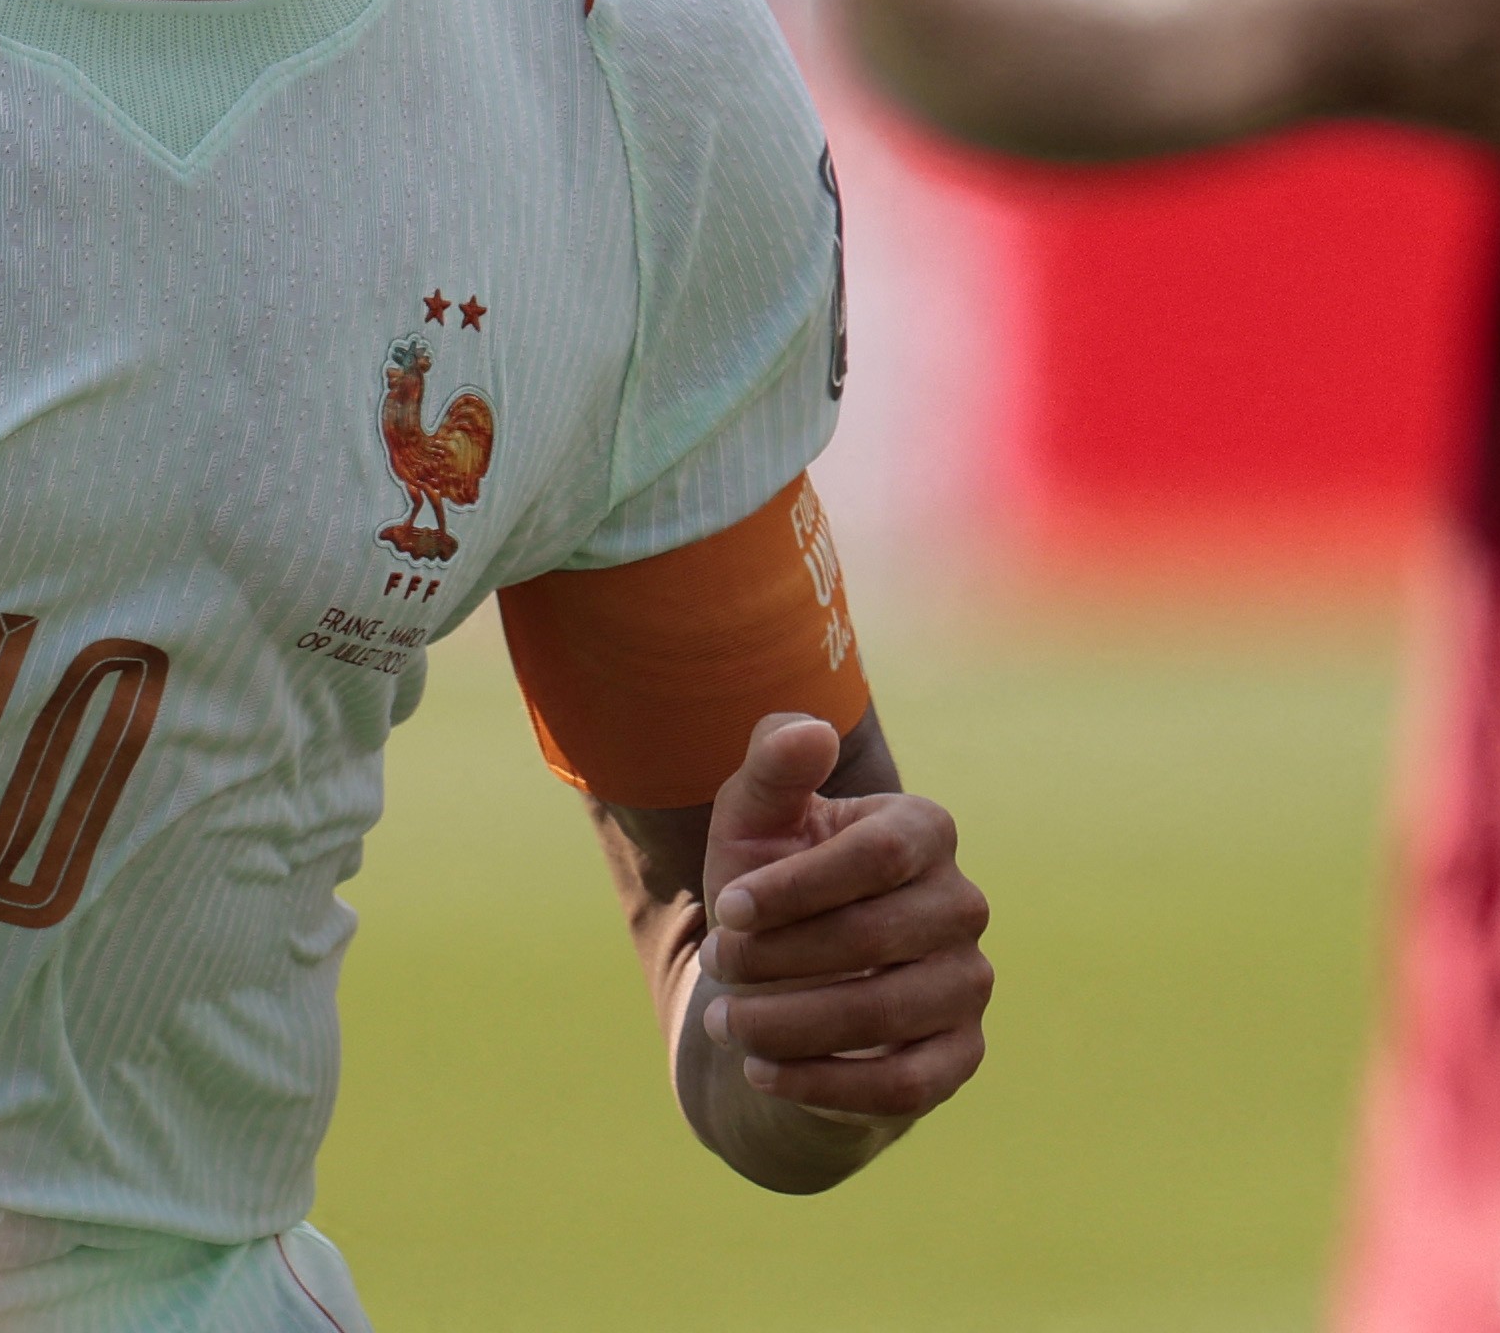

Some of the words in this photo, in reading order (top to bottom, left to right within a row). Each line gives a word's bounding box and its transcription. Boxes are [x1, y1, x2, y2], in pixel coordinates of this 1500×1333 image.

[383, 572, 441, 603] FFF
[319, 607, 384, 642] FRANCE
[297, 632, 331, 652] 09
